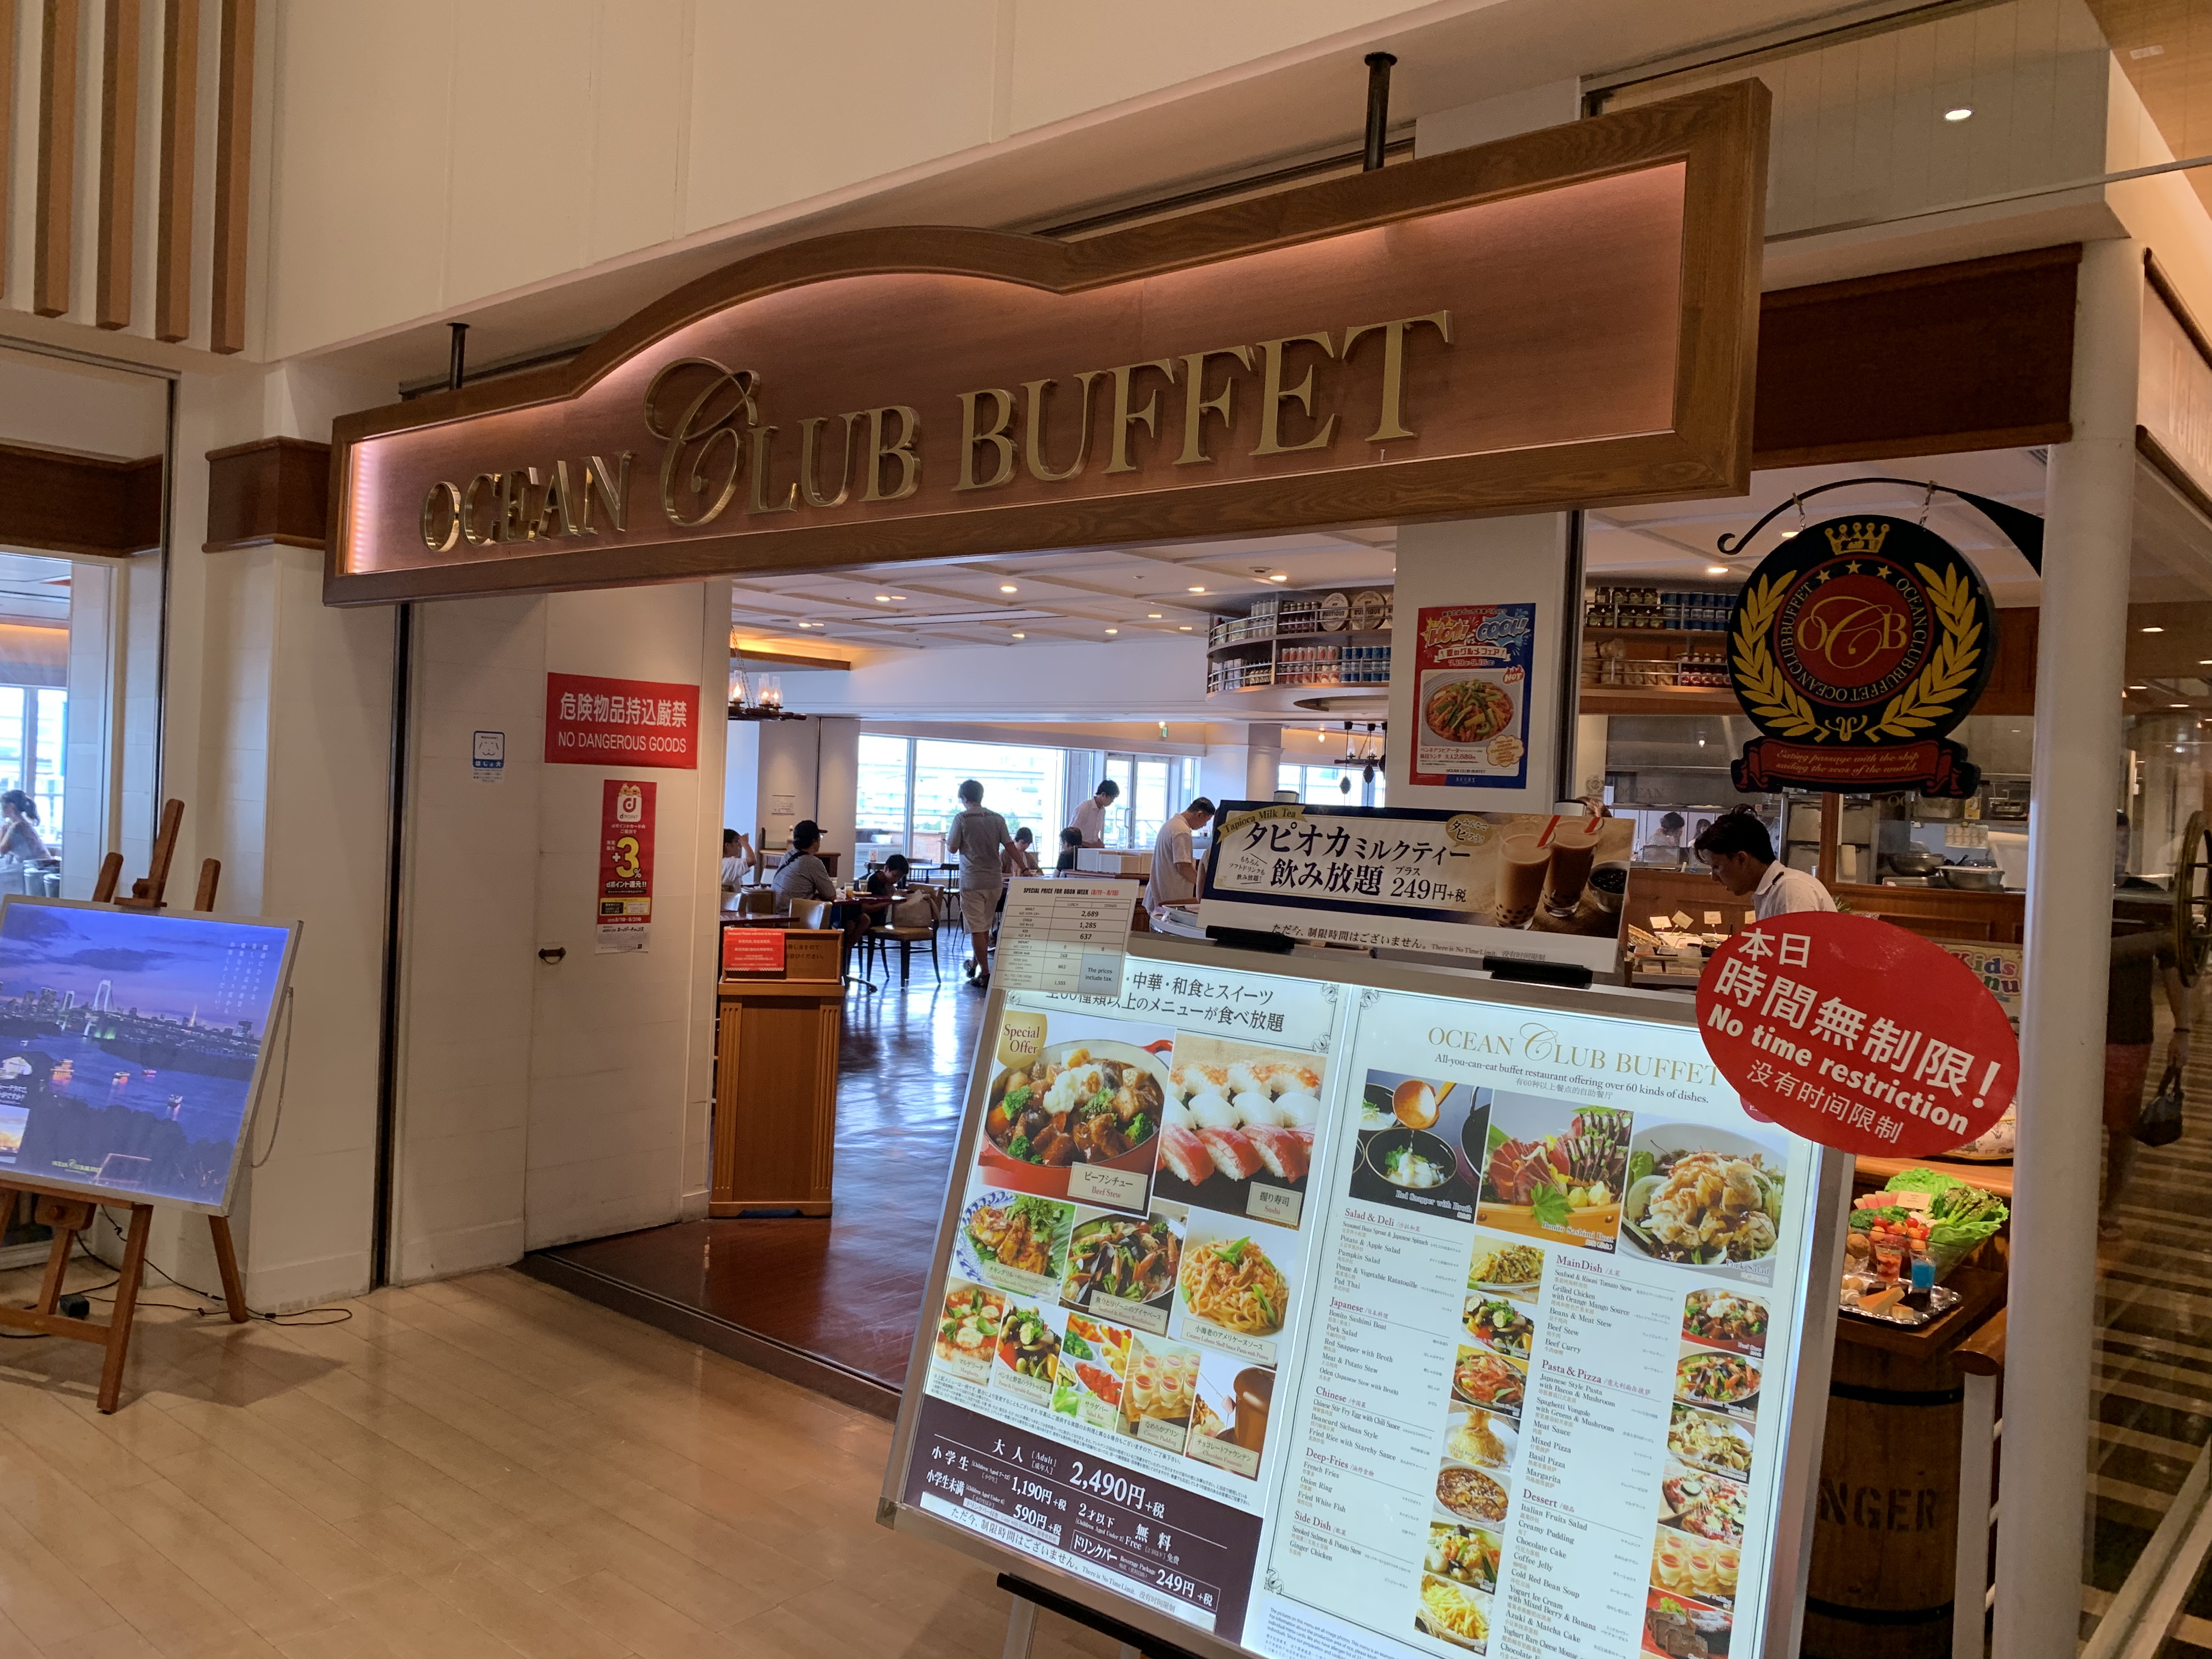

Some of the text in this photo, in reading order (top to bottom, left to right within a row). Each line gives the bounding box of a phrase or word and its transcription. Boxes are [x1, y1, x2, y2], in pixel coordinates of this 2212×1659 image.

[420, 309, 1453, 551] OCEAN CLUB BUFFET
[1781, 578, 1927, 701] OCEAN CLUB BUFFET OCEAN CLUB BUFFET
[1504, 673, 1521, 682] HOT
[560, 692, 687, 728] 危険物品持込厳禁
[558, 731, 686, 753] NO DANGEROUS GOODS
[1808, 754, 1852, 765] passage
[1854, 753, 1876, 762] with
[1880, 753, 1896, 761] the
[1898, 752, 1919, 763] ship
[1776, 762, 1809, 773] sailing
[1811, 764, 1825, 772] the
[1852, 765, 1865, 776] of
[1865, 764, 1880, 773] the
[1883, 763, 1917, 773] world.
[1223, 808, 1296, 833] Tapioca Milk Tea
[1229, 862, 1265, 875] ソフトドリンクも
[1240, 856, 1260, 866] もちろん
[1396, 866, 1420, 876] プラス
[1270, 857, 1385, 896] 飲み放題
[1431, 943, 1447, 951] There
[1738, 928, 1812, 968] 本日
[1003, 1023, 1040, 1041] Special
[1009, 1040, 1038, 1055] Offer
[1428, 1022, 1718, 1086] OCEAN CLUB BUFFET
[1435, 1053, 1497, 1072] All-you-can-eat
[1499, 1063, 1523, 1075] buffet
[1525, 1069, 1567, 1081] restaurant
[1569, 1075, 1604, 1090] offering
[1626, 1083, 1637, 1092] 60
[1639, 1085, 1664, 1096] kinds
[1666, 1090, 1678, 1098] of
[1678, 1090, 1709, 1103] dishes.
[1707, 1003, 1970, 1136] No time restriction
[1515, 1077, 1613, 1100] 有60种以上餐点的自助餐厅
[1746, 1059, 1905, 1144] 没有时间限制
[1085, 1171, 1133, 1188] ビーフシチュー
[1091, 1186, 1121, 1199] Beef Stew
[1259, 1192, 1290, 1207] 握り寿司
[1396, 1190, 1472, 1214] Red Snapper with Broth
[1264, 1205, 1280, 1215] Sushi
[1345, 1208, 1394, 1227] Salad & Deli
[1542, 1221, 1614, 1243] Bonito Sashimi Boat
[1338, 1249, 1381, 1265] Pumpkin Salad
[1726, 1259, 1770, 1276] Pork Salad
[1329, 1296, 1364, 1313] Japanese
[1547, 1323, 1579, 1336] Beef Stew
[1545, 1338, 1582, 1353] Beef Curry
[958, 1358, 984, 1370] マルゲリータ
[1542, 1359, 1602, 1384] Pasta & Pizza
[1316, 1386, 1347, 1402] Chinese
[1085, 1401, 1109, 1413] サラダバー
[1143, 1430, 1177, 1446] Creamy Pudding
[1144, 1421, 1179, 1437] なめらかプリン
[932, 1446, 969, 1471] 小学生
[992, 1438, 1023, 1463] 大人
[1197, 1438, 1251, 1462] チョコレートファウンテン
[1203, 1451, 1243, 1468] Chocolate Fountain
[1306, 1447, 1348, 1469] Deep-Fries
[926, 1469, 965, 1497] 小学生未満
[1522, 1488, 1558, 1508] Dessert
[1078, 1503, 1115, 1528] 2才以下
[1294, 1510, 1331, 1531] Side Dish
[1125, 1536, 1142, 1550] Free
[1135, 1523, 1172, 1551] 無料
[1074, 1534, 1118, 1561] ドリンクバー
[1082, 1566, 1096, 1577] There
[1109, 1577, 1121, 1588] Time
[1139, 1592, 1176, 1612] 没有时间限制
